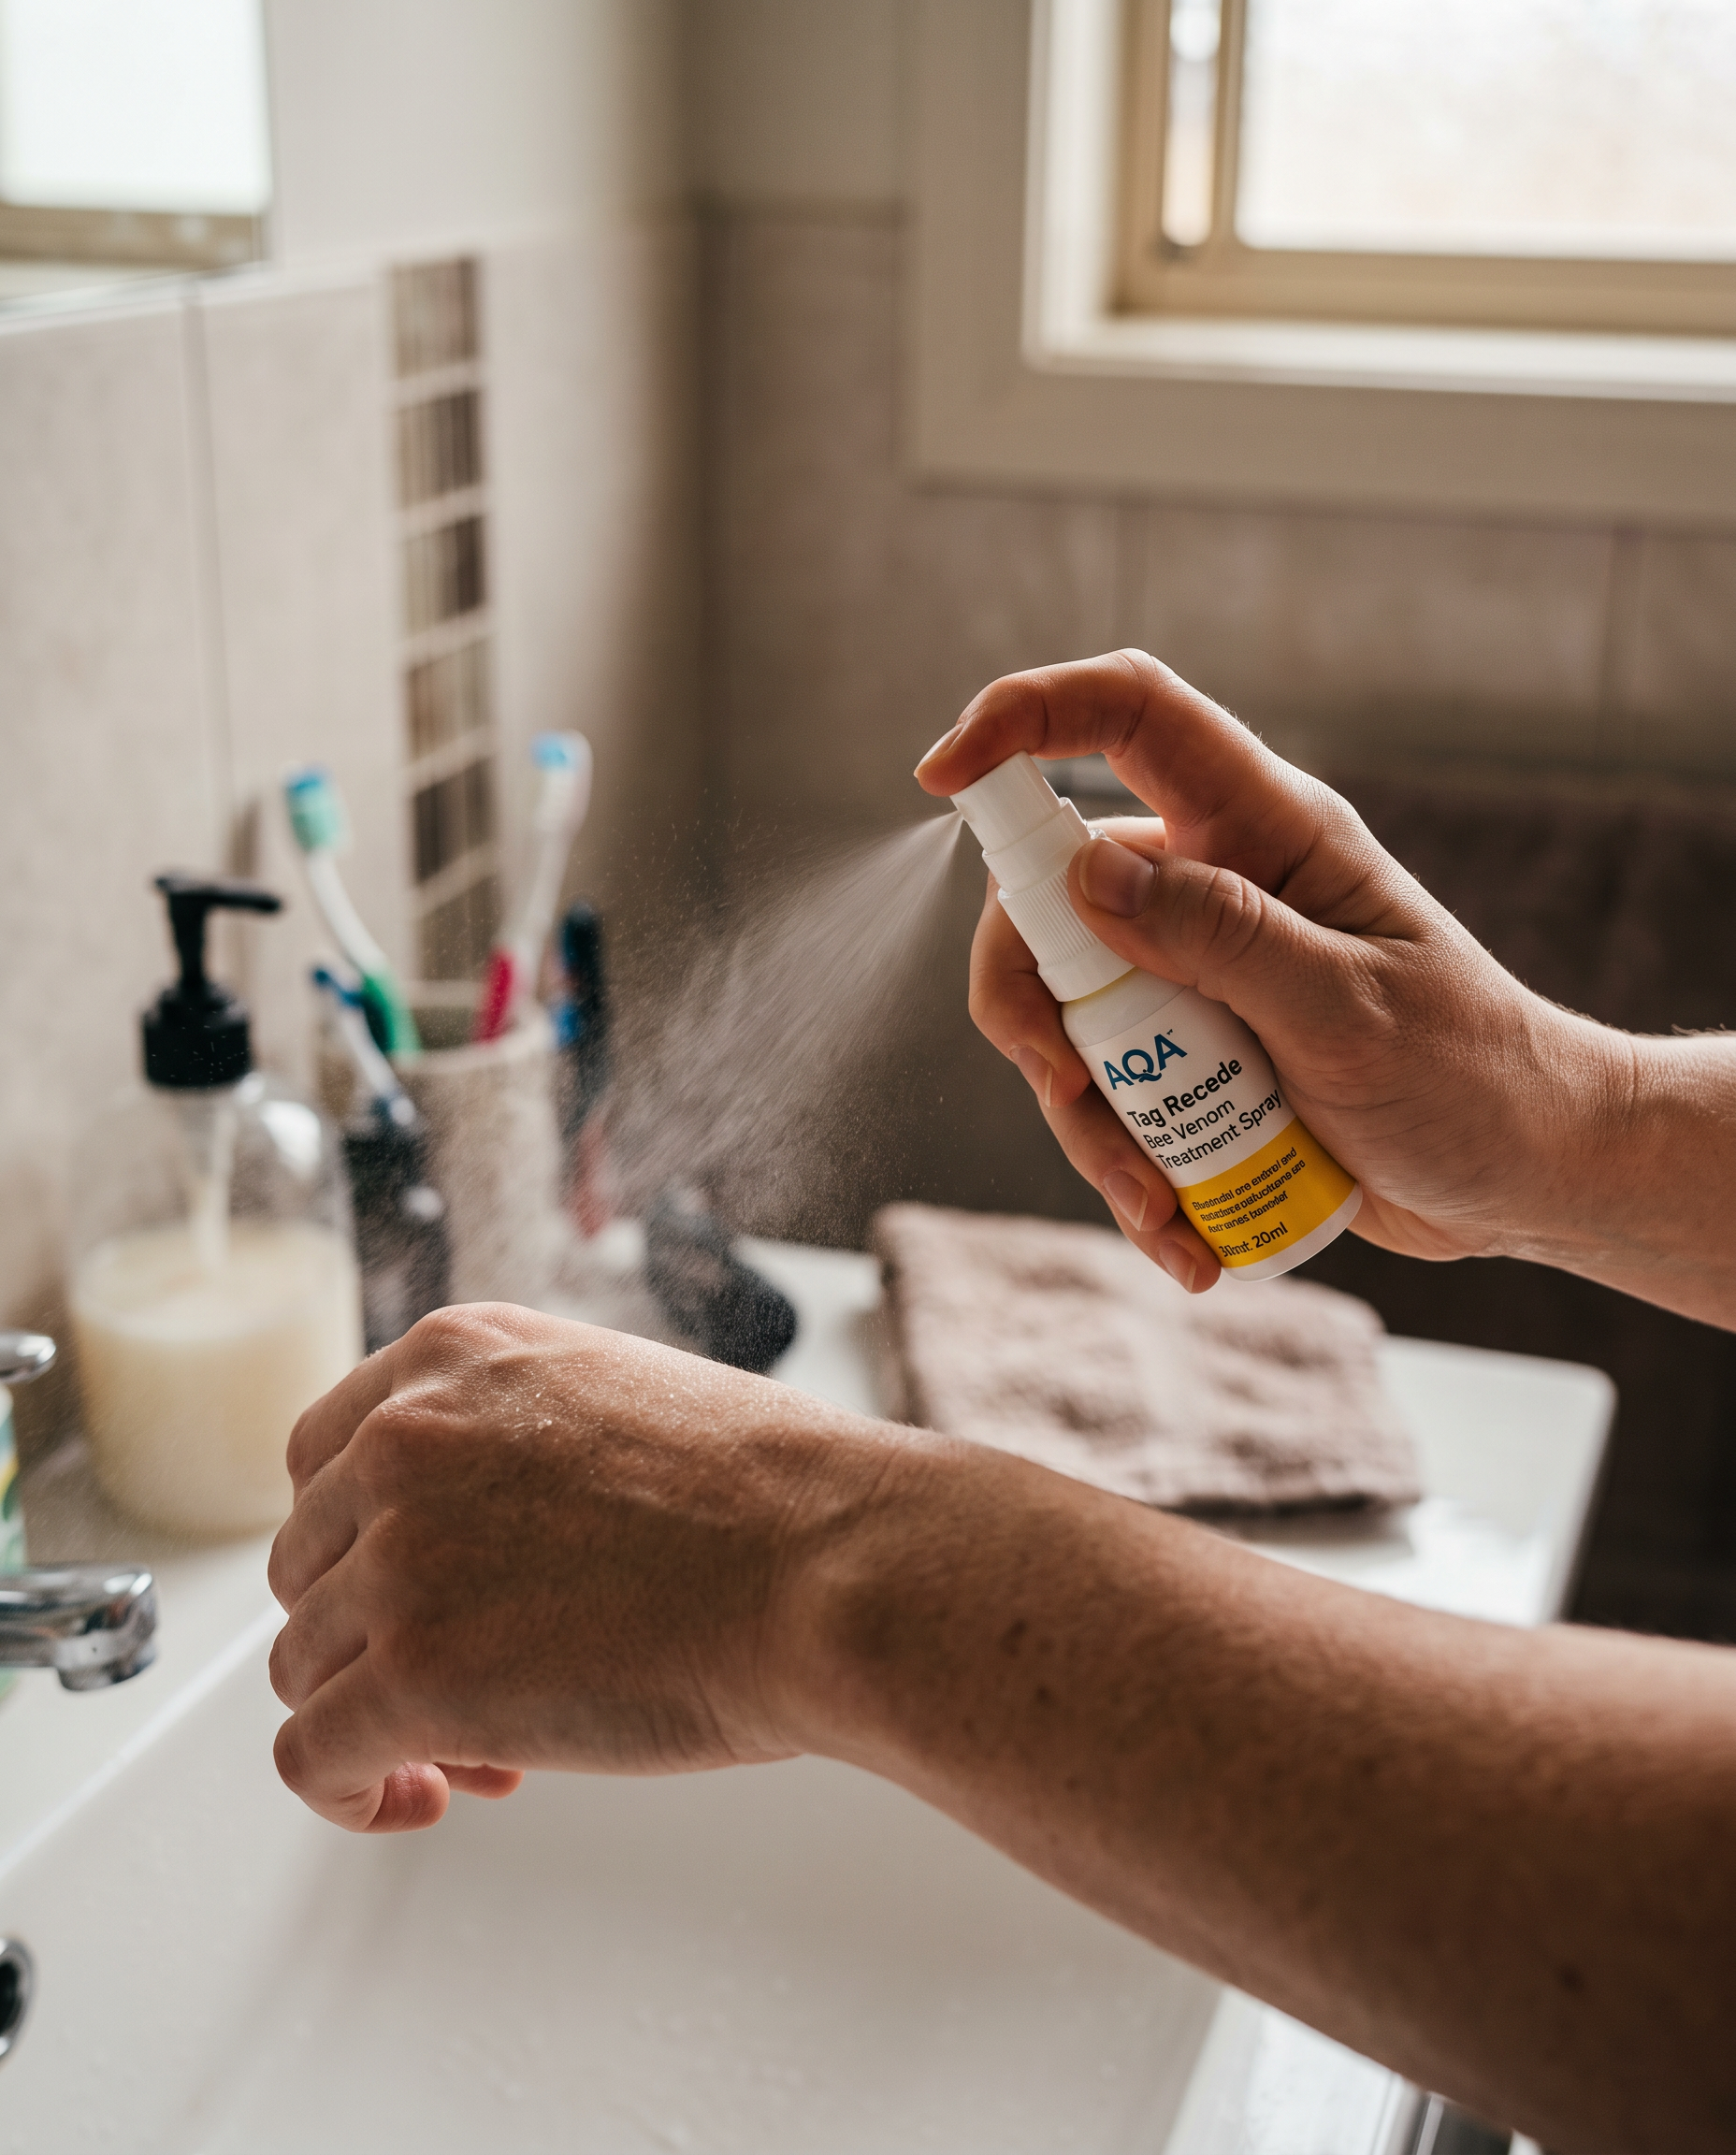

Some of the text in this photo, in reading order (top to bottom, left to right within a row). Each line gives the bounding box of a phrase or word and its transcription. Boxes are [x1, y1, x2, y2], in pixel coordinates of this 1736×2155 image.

[1103, 1034, 1188, 1091] AQA
[1126, 1059, 1242, 1128] Tag Recede
[1143, 1100, 1236, 1150] Bee Venom
[1155, 1089, 1282, 1169] Treatment Spray
[1251, 1222, 1289, 1249] 20ml
